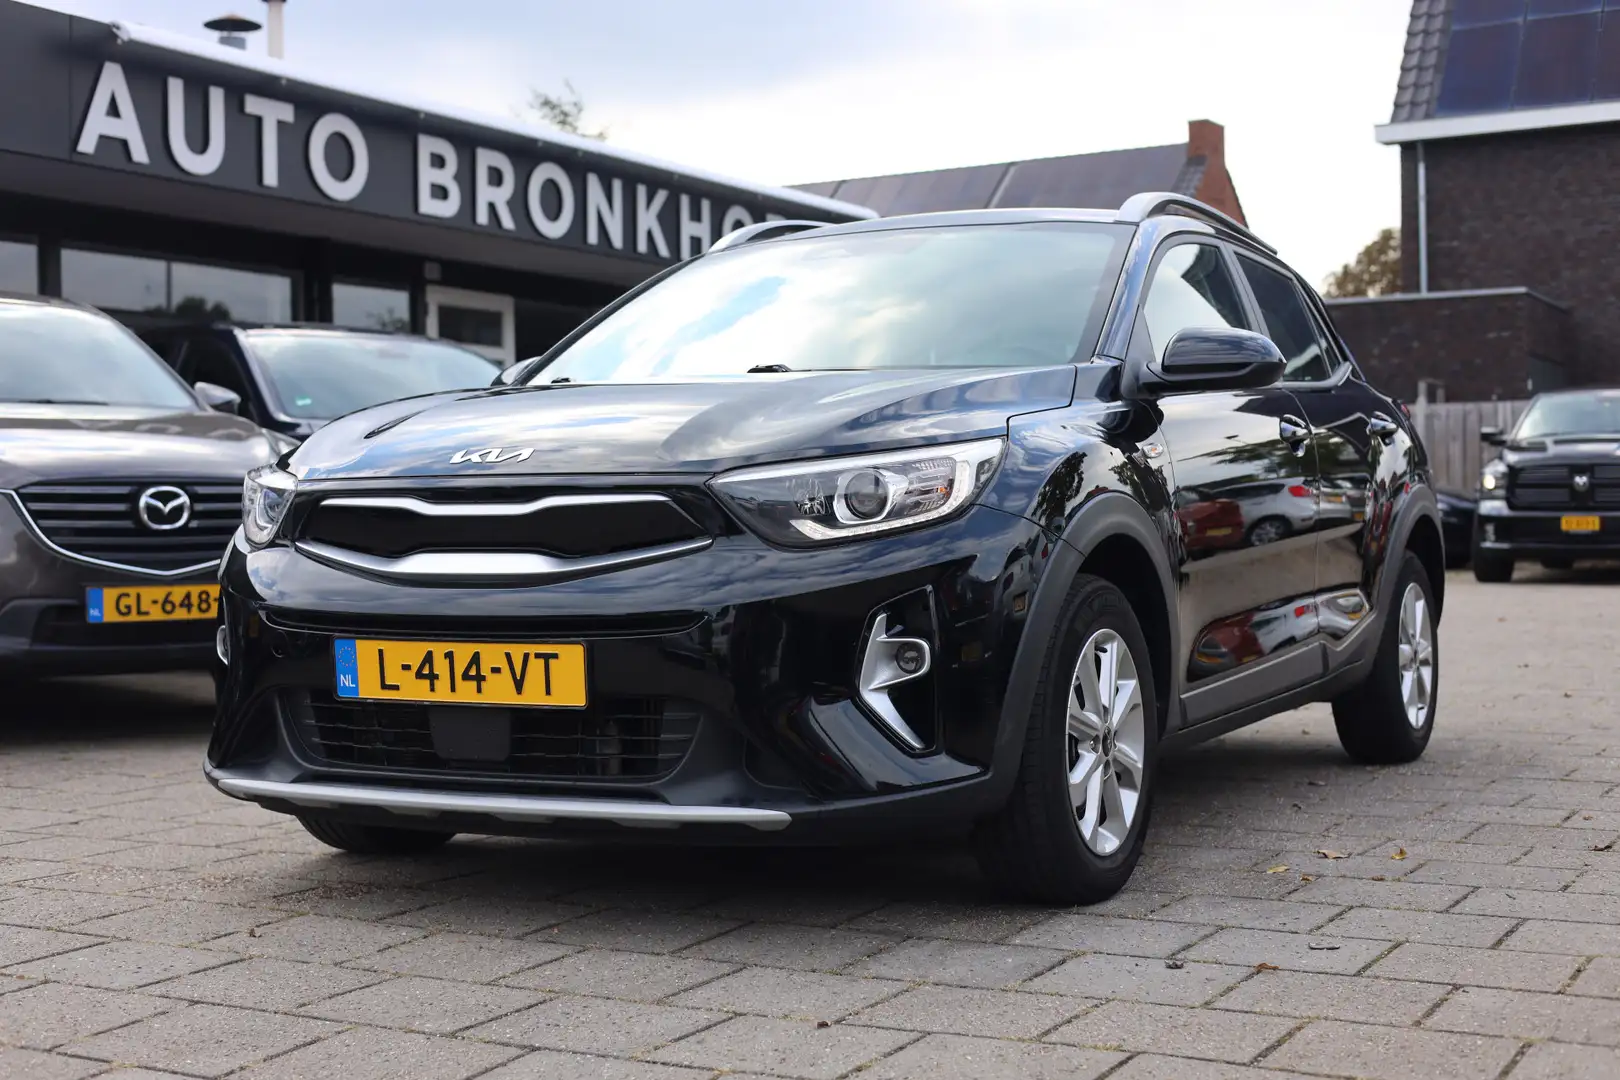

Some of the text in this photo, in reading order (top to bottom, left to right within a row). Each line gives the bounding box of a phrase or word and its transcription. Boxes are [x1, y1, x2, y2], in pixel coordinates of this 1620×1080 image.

[75, 60, 786, 262] AUTO BRONKH
[449, 447, 535, 464] KIA
[89, 607, 101, 616] NL
[339, 647, 560, 696] NL L-414-VT
